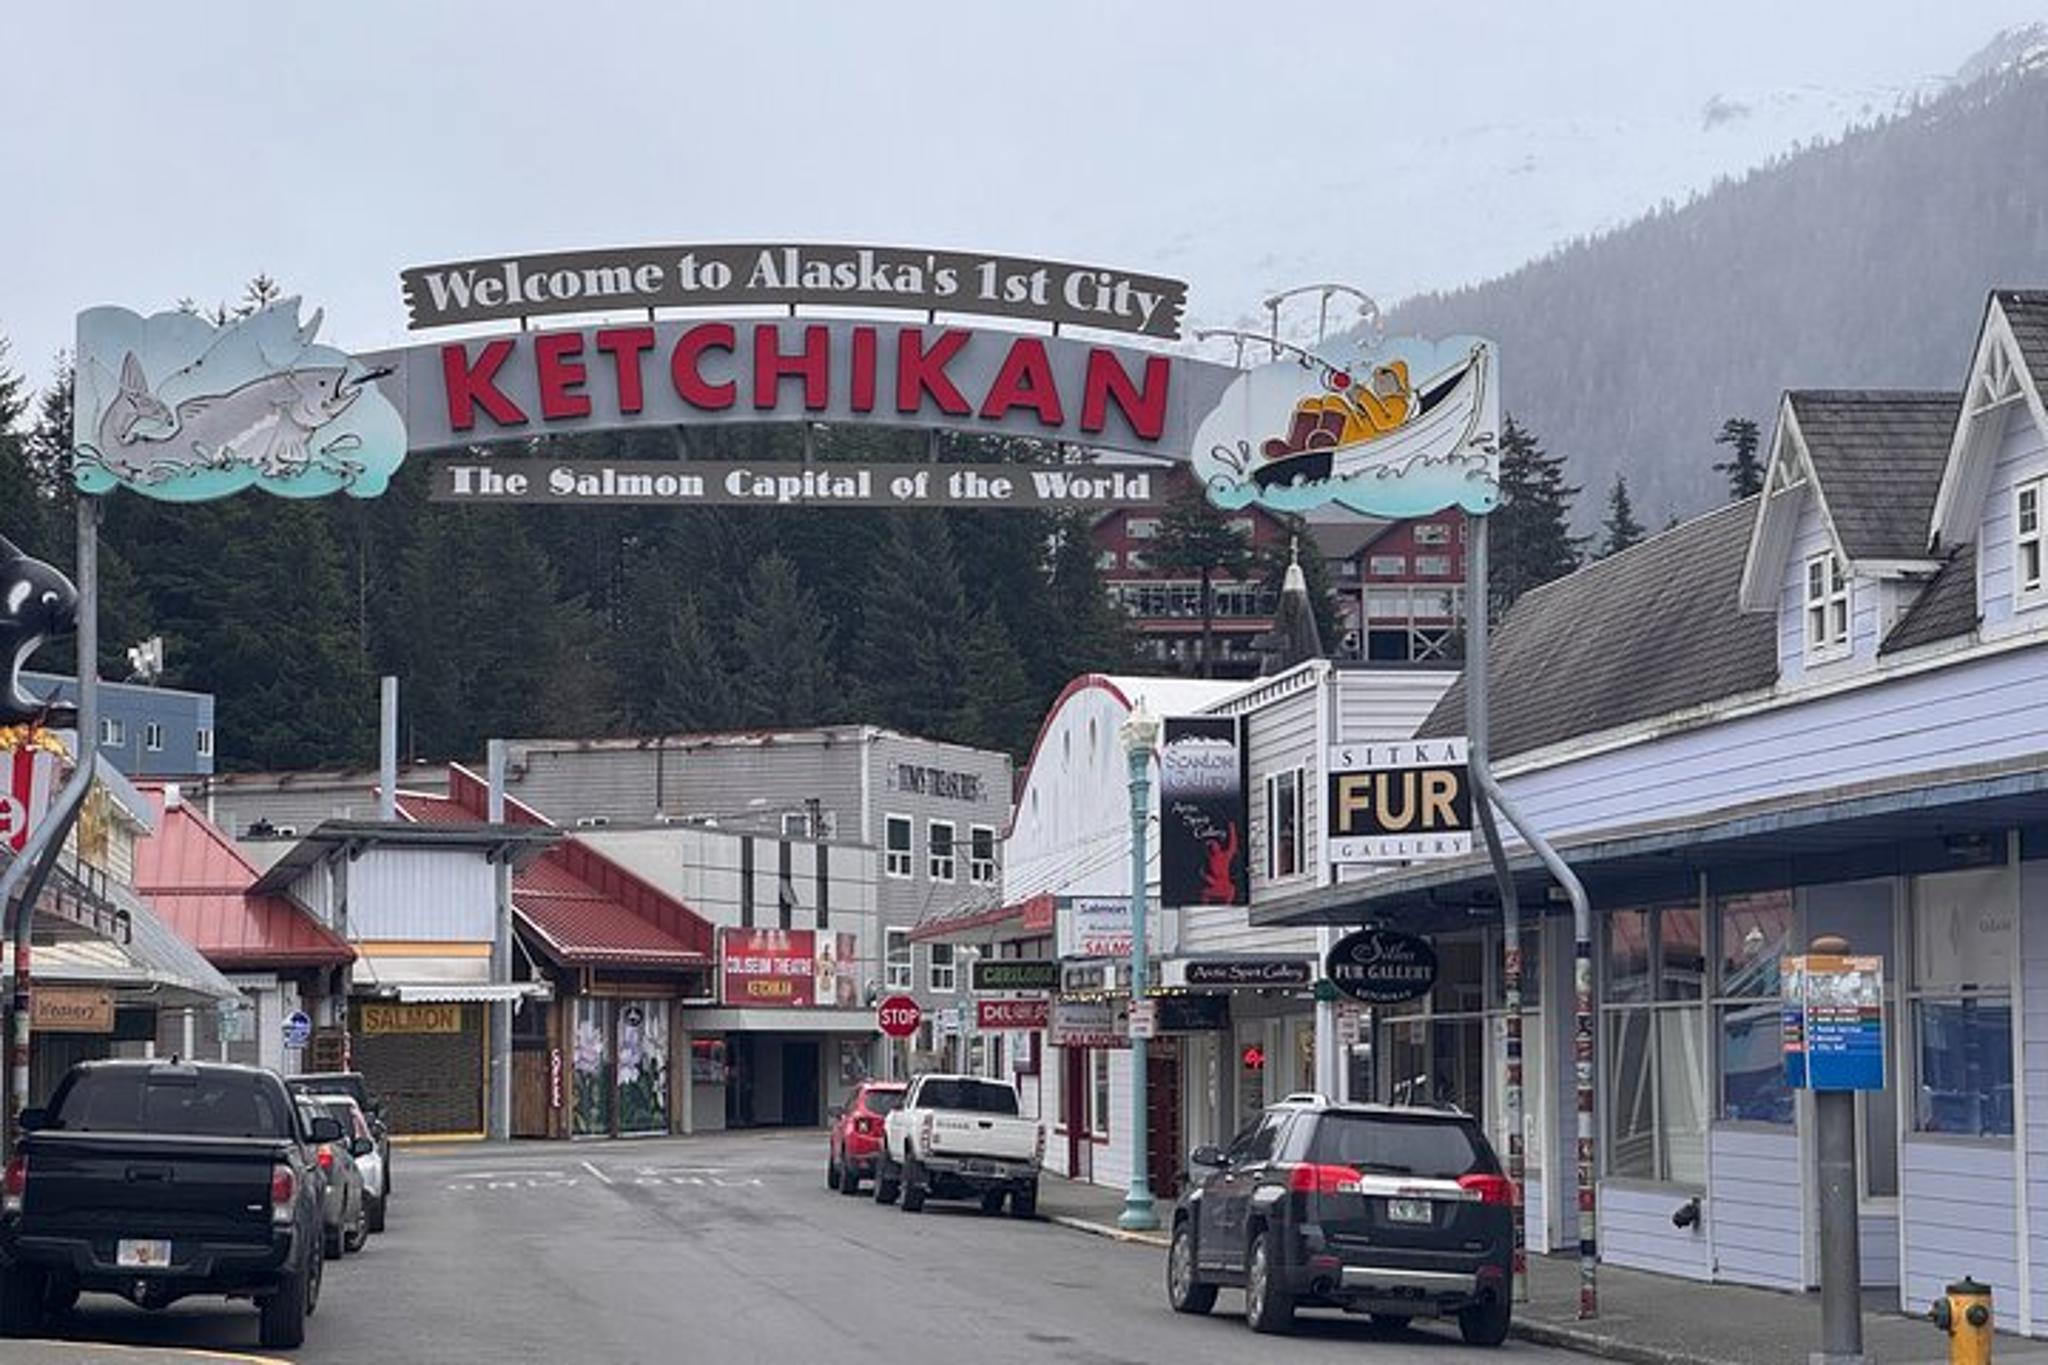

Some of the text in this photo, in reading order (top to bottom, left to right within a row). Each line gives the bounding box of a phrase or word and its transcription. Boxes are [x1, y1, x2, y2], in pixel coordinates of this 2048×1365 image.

[423, 248, 1166, 329] Welcome to Alaska's 1st City
[440, 322, 1170, 442] KETCHIKAN
[449, 465, 1150, 503] The Salmon Capital of the World
[1342, 745, 1457, 767] SITKA
[1338, 770, 1460, 832] FUR
[1342, 839, 1462, 858] GALLERY
[366, 1007, 454, 1030] SALMON
[881, 1008, 919, 1026] STOP
